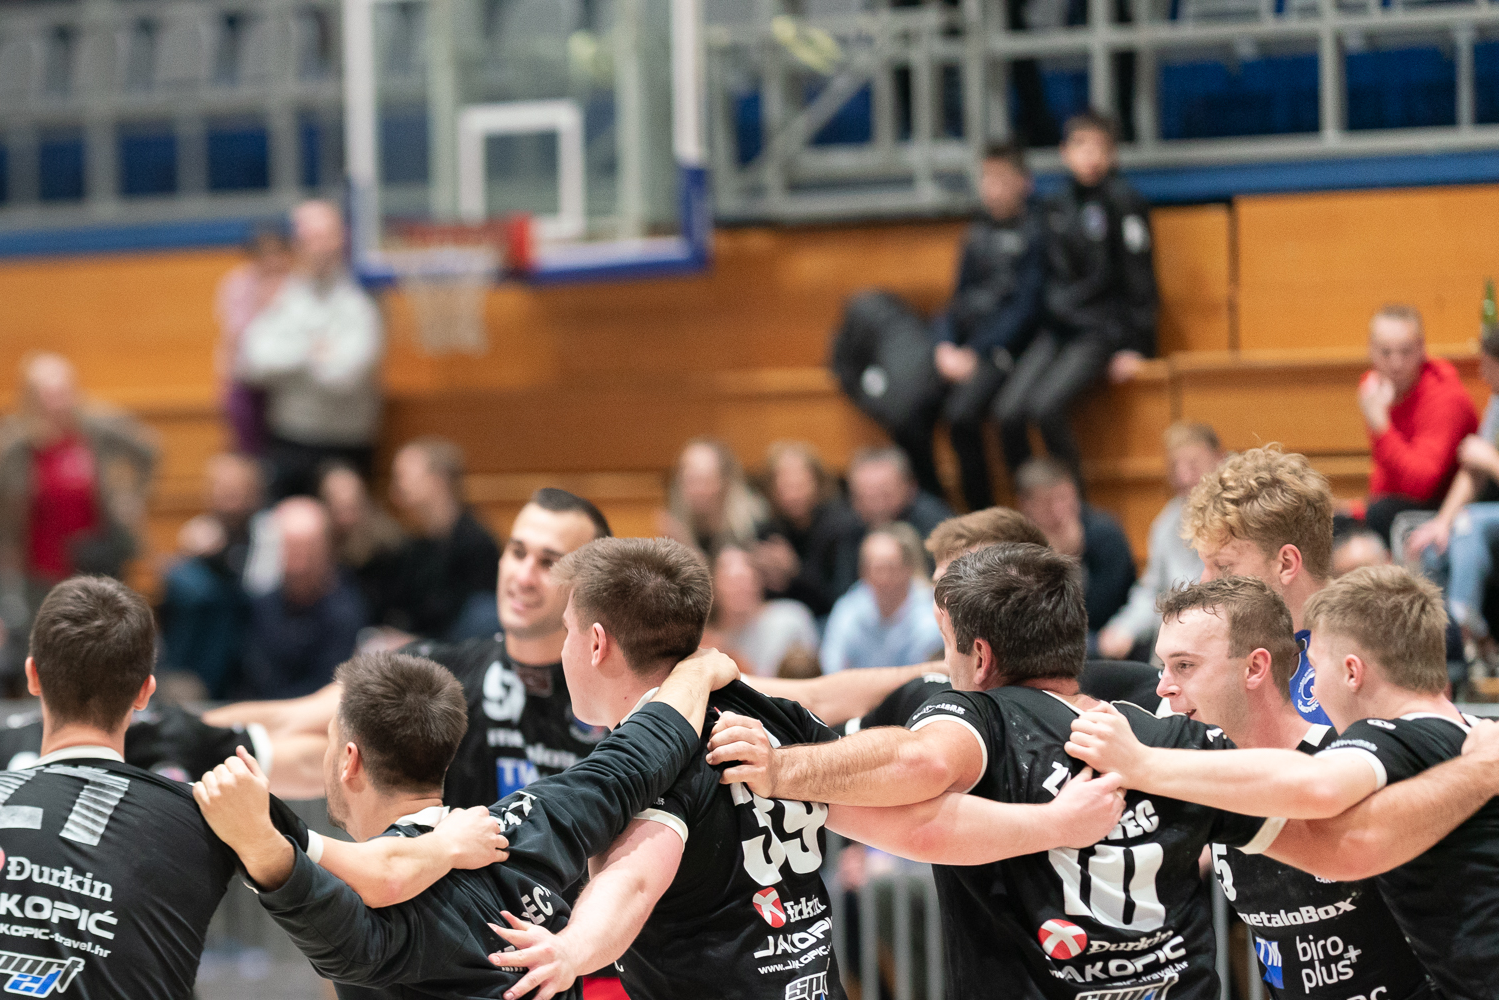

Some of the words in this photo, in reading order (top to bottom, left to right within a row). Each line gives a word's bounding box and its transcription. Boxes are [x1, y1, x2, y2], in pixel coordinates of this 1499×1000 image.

[1256, 937, 1282, 967] TM
[1296, 934, 1344, 962] biro
[1301, 960, 1354, 994] plus
